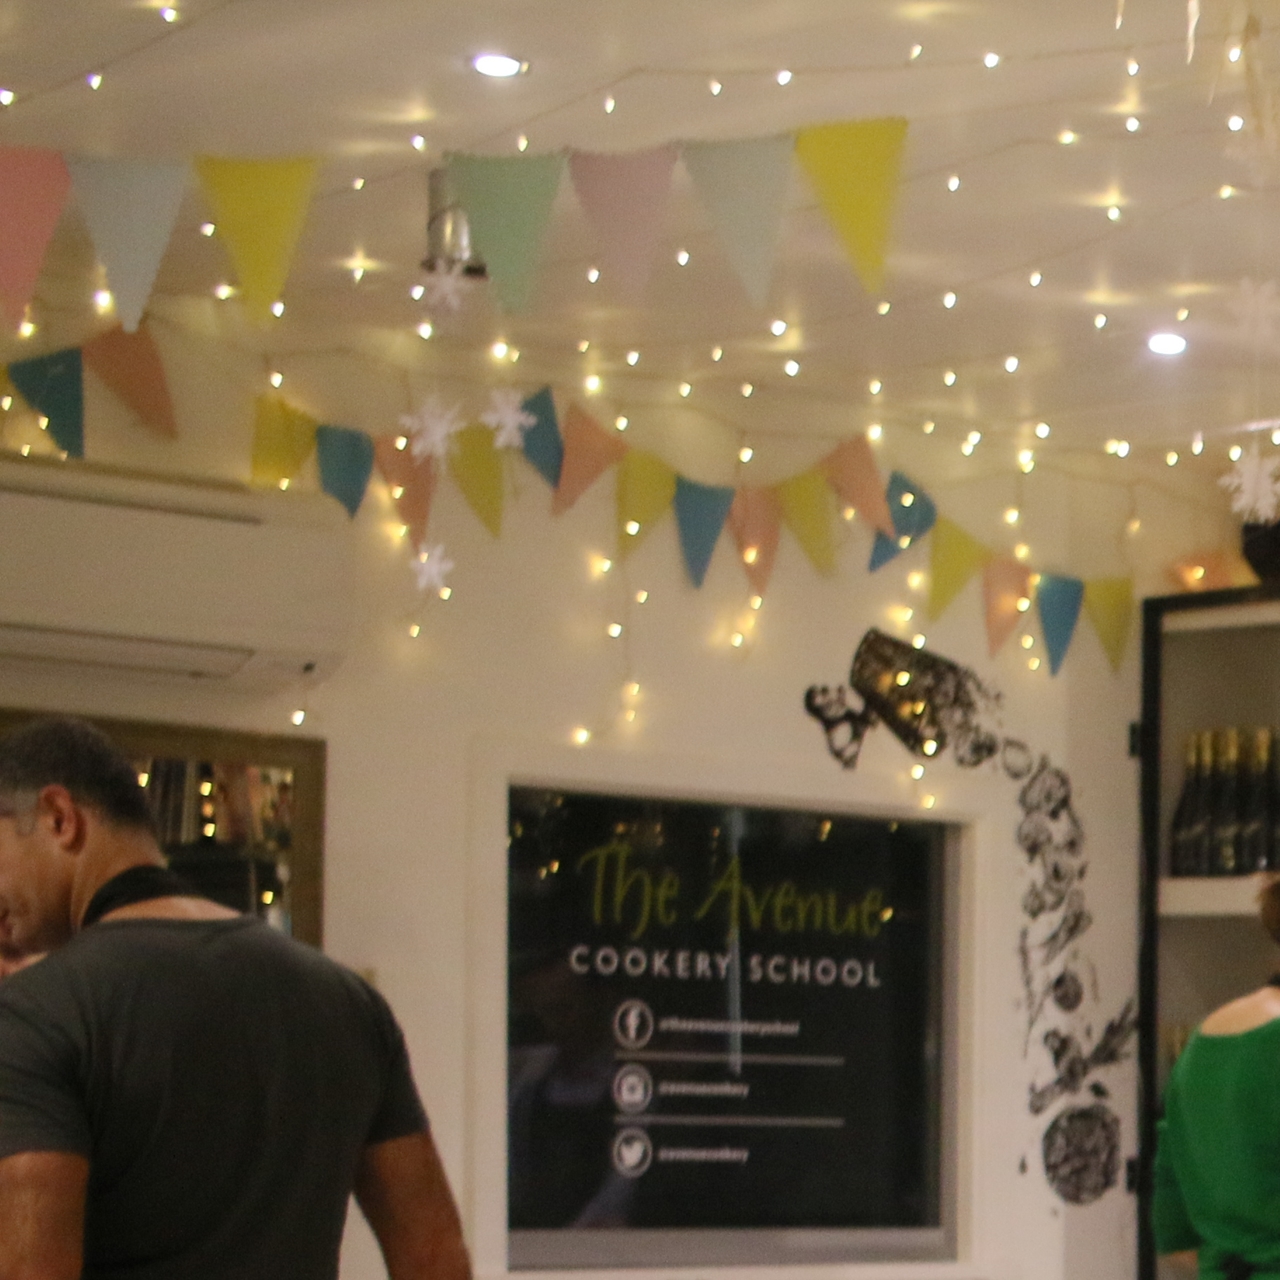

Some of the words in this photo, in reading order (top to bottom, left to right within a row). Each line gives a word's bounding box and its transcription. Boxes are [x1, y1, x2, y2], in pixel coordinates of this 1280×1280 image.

[580, 838, 680, 941] The
[694, 852, 885, 944] Avenue
[568, 943, 731, 978] COOKERY
[748, 951, 882, 988] SCHOOL
